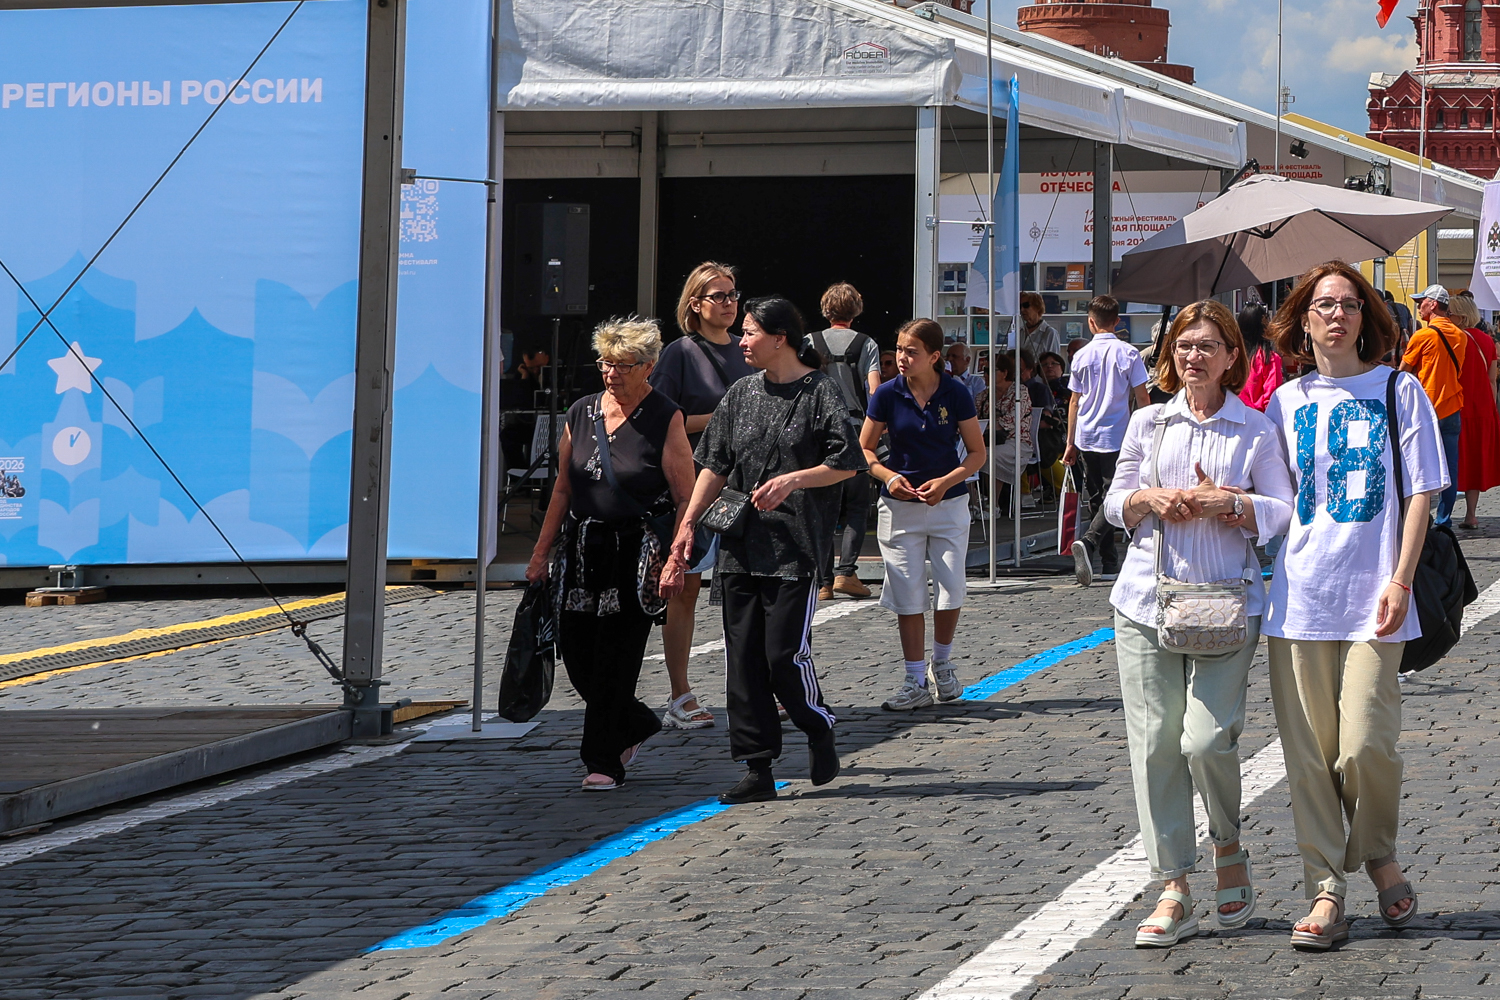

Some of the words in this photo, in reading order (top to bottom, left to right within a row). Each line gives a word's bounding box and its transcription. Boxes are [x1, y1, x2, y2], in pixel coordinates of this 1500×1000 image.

[846, 51, 883, 59] RÖDER
[2, 80, 171, 108] РЕГИОНЫ
[181, 78, 322, 105] РОССИИ
[1040, 181, 1121, 193] ОТЕЧЕСА
[0, 460, 25, 470] 2026
[1294, 399, 1388, 526] 18
